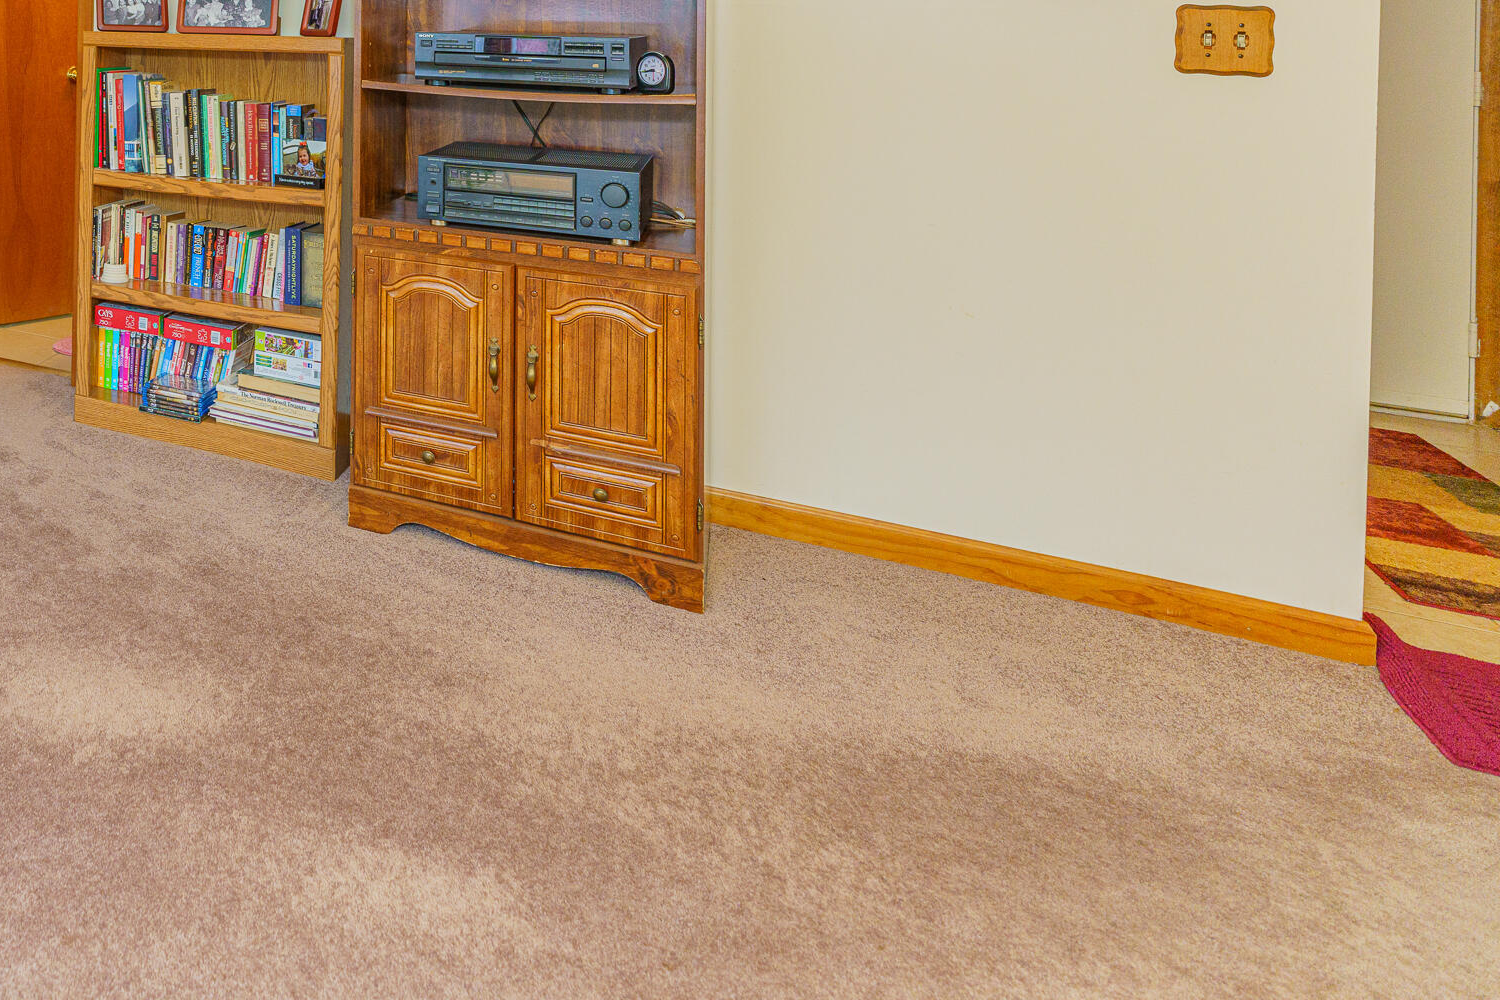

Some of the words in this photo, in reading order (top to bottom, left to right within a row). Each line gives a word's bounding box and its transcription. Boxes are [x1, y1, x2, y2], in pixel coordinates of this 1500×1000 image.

[97, 309, 114, 318] CATS
[249, 393, 267, 402] Norman
[267, 397, 287, 407] Rockwell
